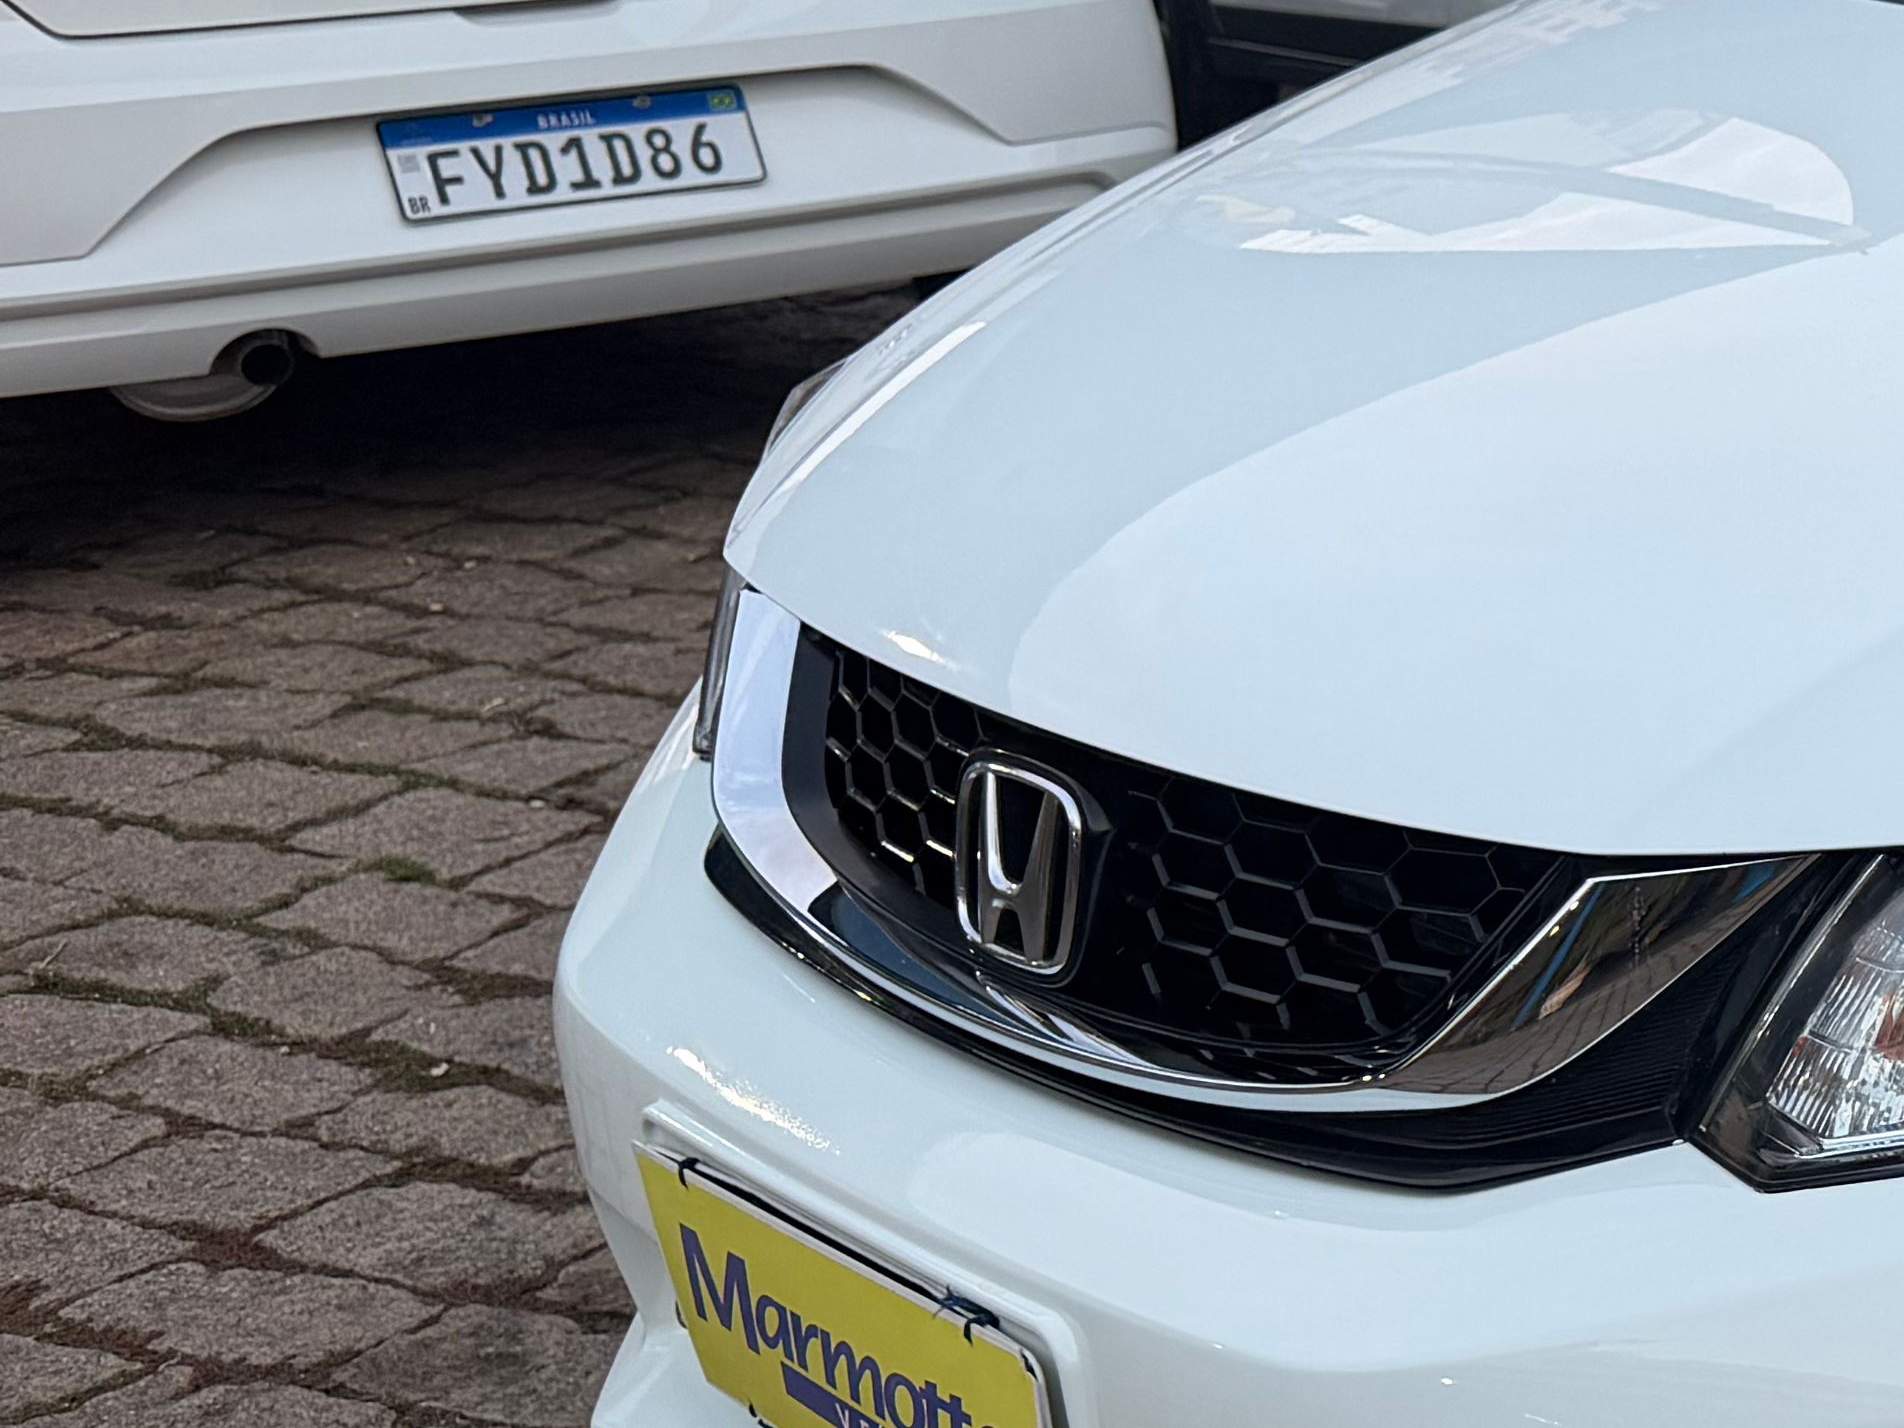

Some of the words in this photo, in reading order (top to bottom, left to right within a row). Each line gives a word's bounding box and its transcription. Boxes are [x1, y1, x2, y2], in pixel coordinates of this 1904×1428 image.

[537, 109, 597, 130] BRASIL
[427, 122, 723, 207] FYD1D86
[408, 195, 431, 215] BR
